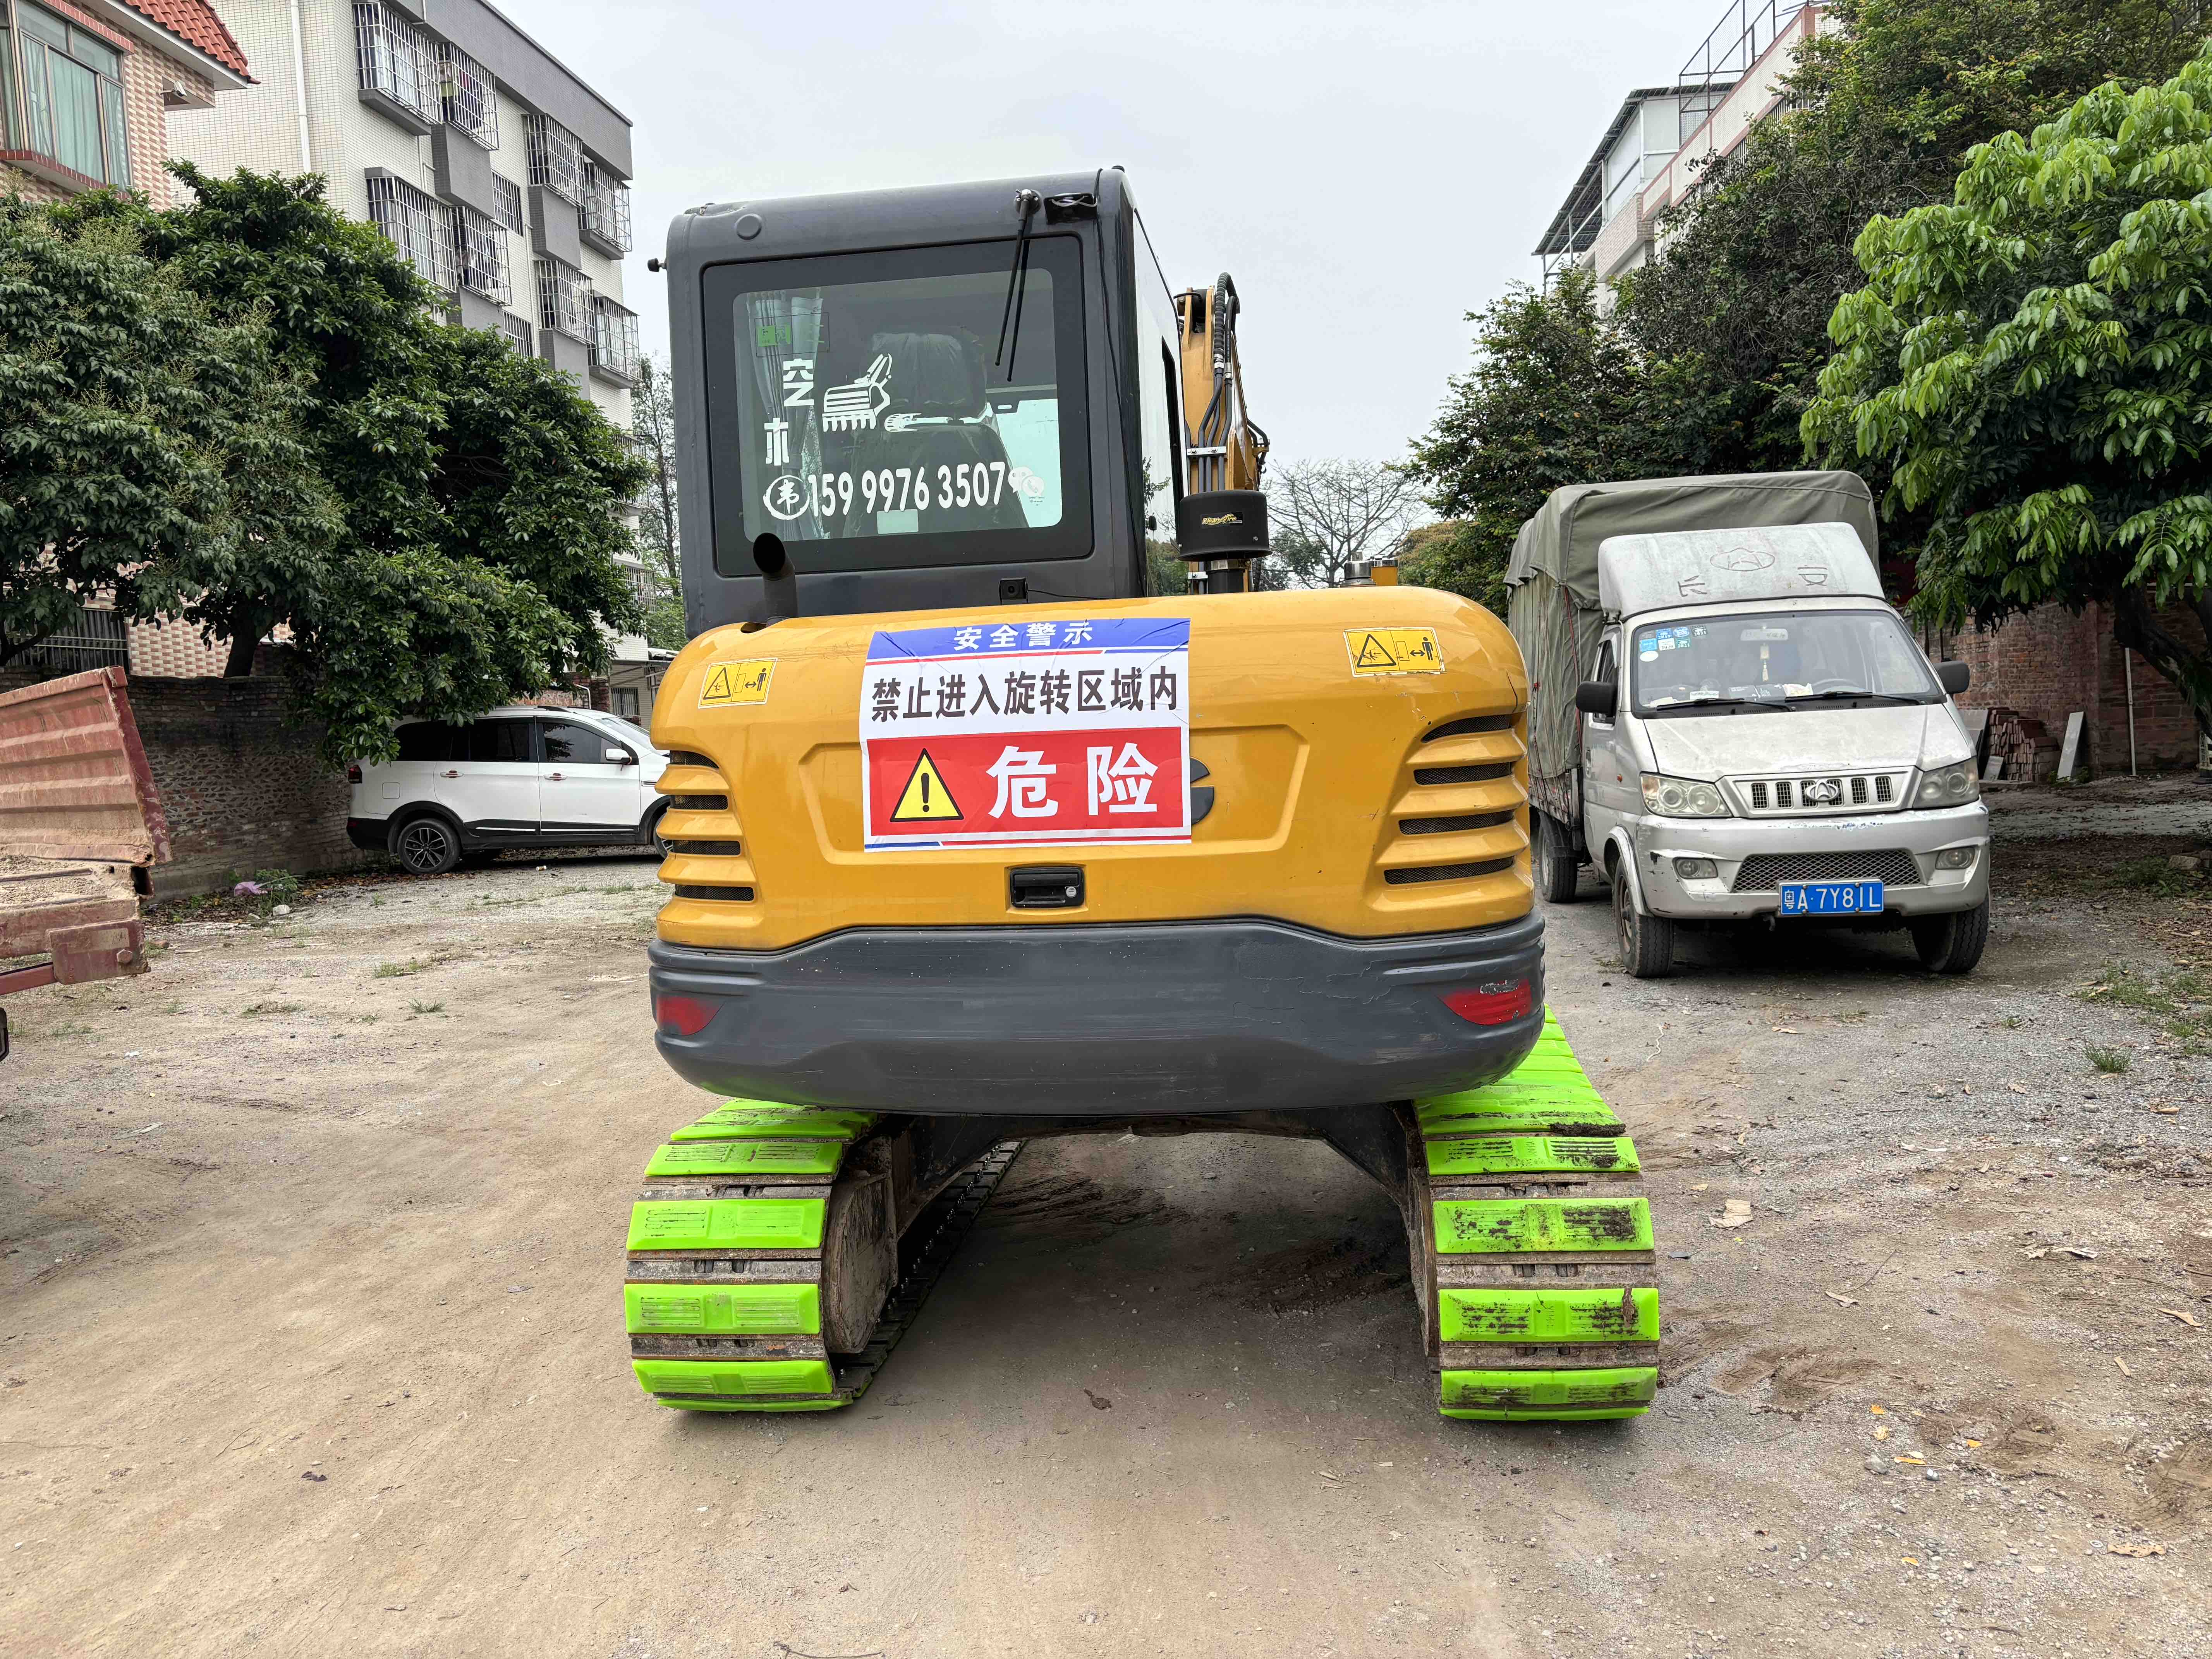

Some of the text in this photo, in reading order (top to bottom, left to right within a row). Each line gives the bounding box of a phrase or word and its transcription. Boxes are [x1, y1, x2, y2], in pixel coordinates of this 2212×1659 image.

[808, 462, 1005, 517] 159 9976 3507
[954, 622, 1093, 651] 安全警示
[872, 666, 1177, 723] 禁止进入旋转区域内
[986, 743, 1158, 819] 危险
